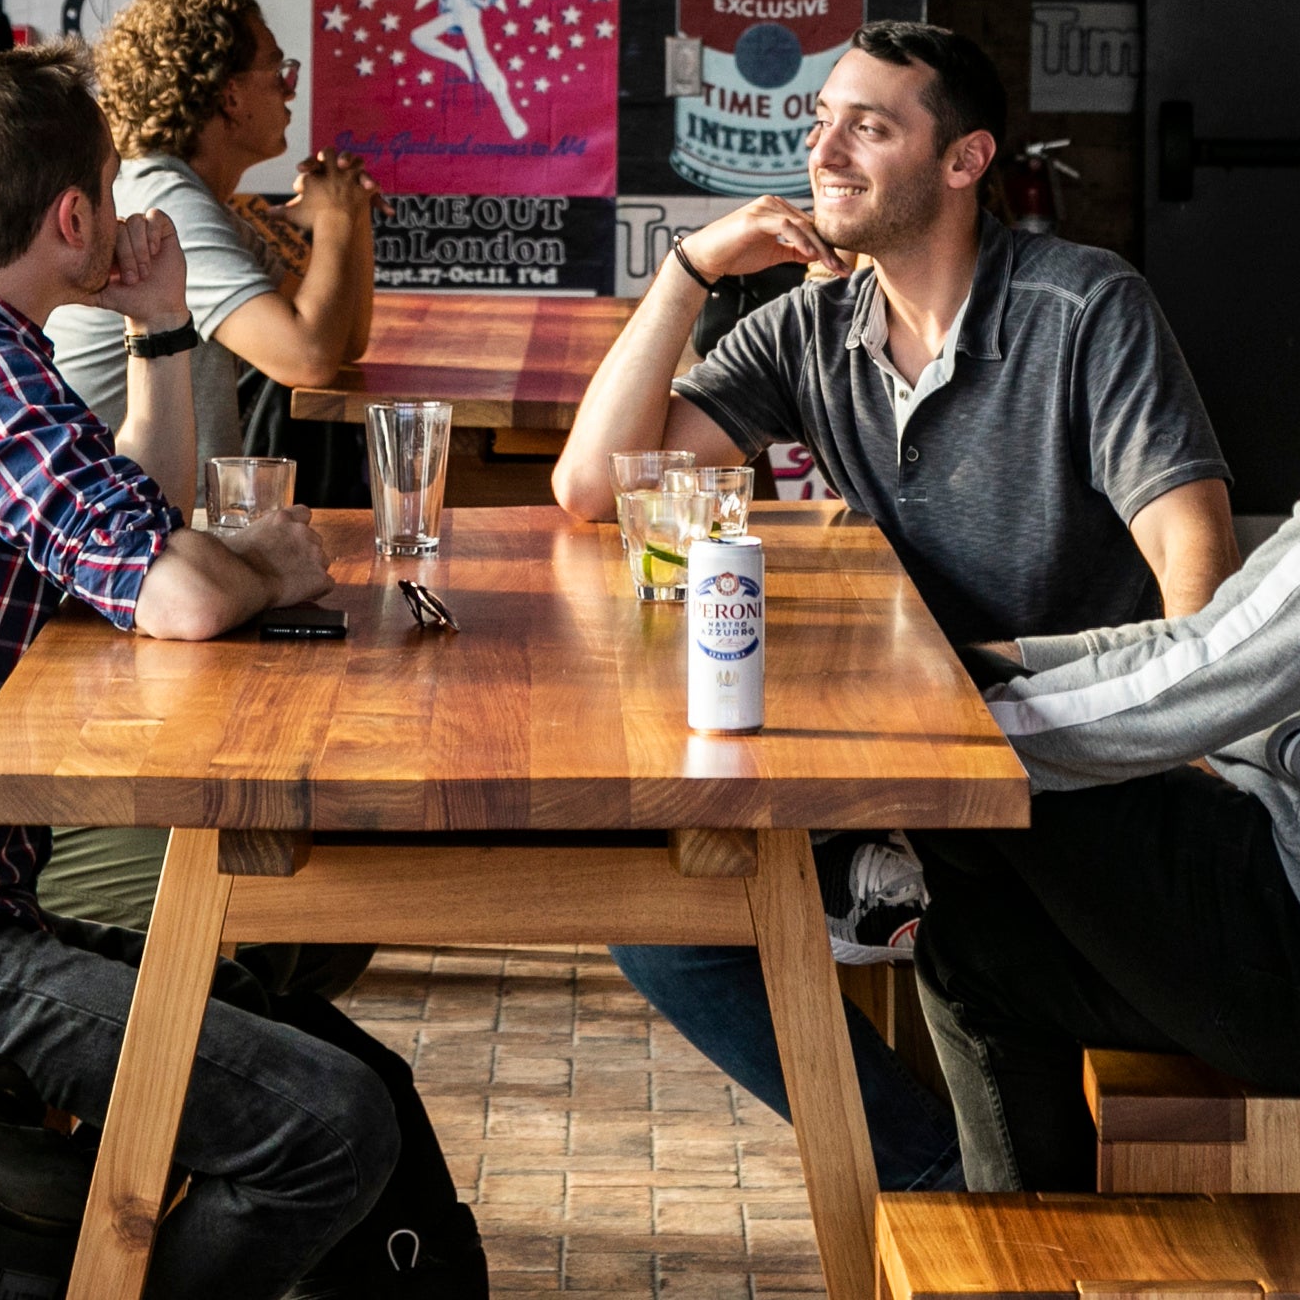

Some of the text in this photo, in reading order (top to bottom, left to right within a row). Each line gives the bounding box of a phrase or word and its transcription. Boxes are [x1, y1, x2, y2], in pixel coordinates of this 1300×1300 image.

[1032, 6, 1140, 78] Tim
[702, 81, 823, 119] TIME OU
[335, 129, 384, 163] Judy
[389, 131, 473, 163] Garland
[688, 112, 815, 157] INTERV
[472, 196, 569, 231] OUT
[375, 230, 567, 265] n London
[694, 602, 762, 620] PERONI
[708, 621, 748, 629] NASTRO
[700, 627, 756, 637] AZZURRO
